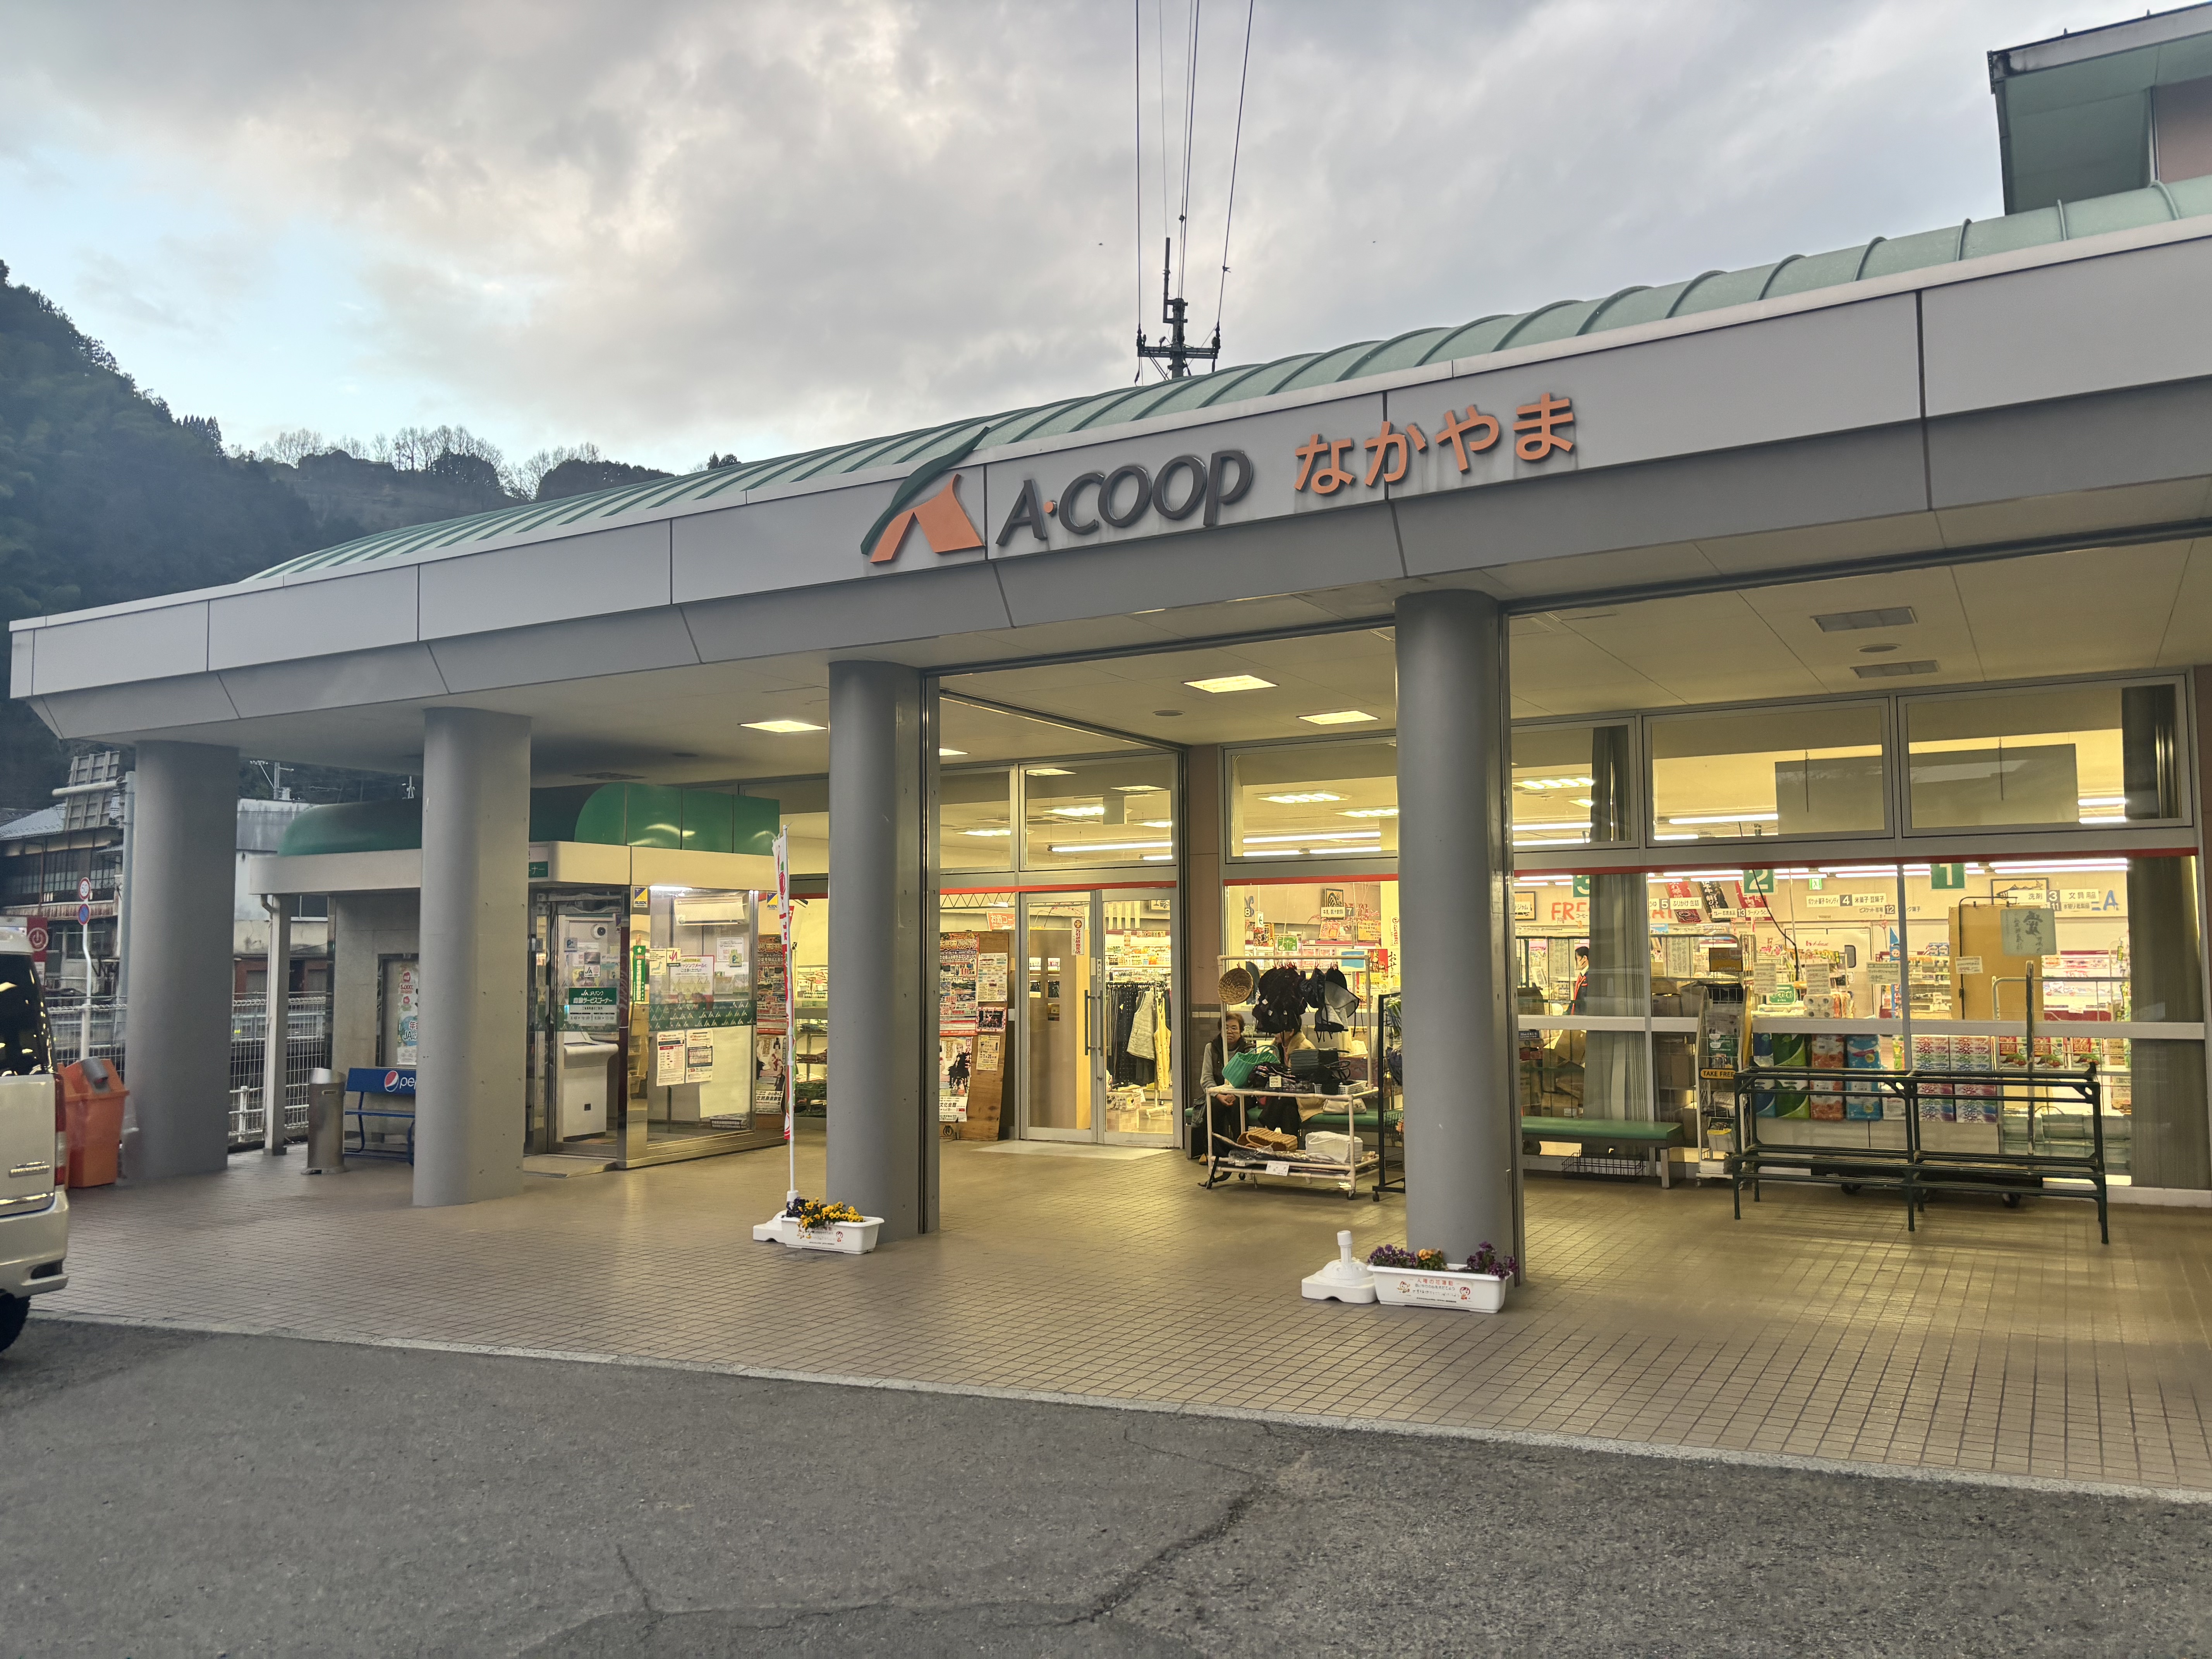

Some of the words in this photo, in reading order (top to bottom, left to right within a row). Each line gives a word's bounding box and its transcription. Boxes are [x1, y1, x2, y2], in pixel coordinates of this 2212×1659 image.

[1293, 391, 1575, 496] なかやま
[1939, 864, 1953, 886] 1
[1748, 870, 1768, 890] 2
[1842, 895, 1850, 905] 4
[2049, 891, 2057, 901] 3
[1661, 899, 1668, 908] 5
[1245, 908, 1250, 917] 8
[1346, 908, 1353, 916] 7
[1737, 909, 1746, 917] 13
[1886, 905, 1895, 914] 12
[990, 915, 1015, 924] お酒コー
